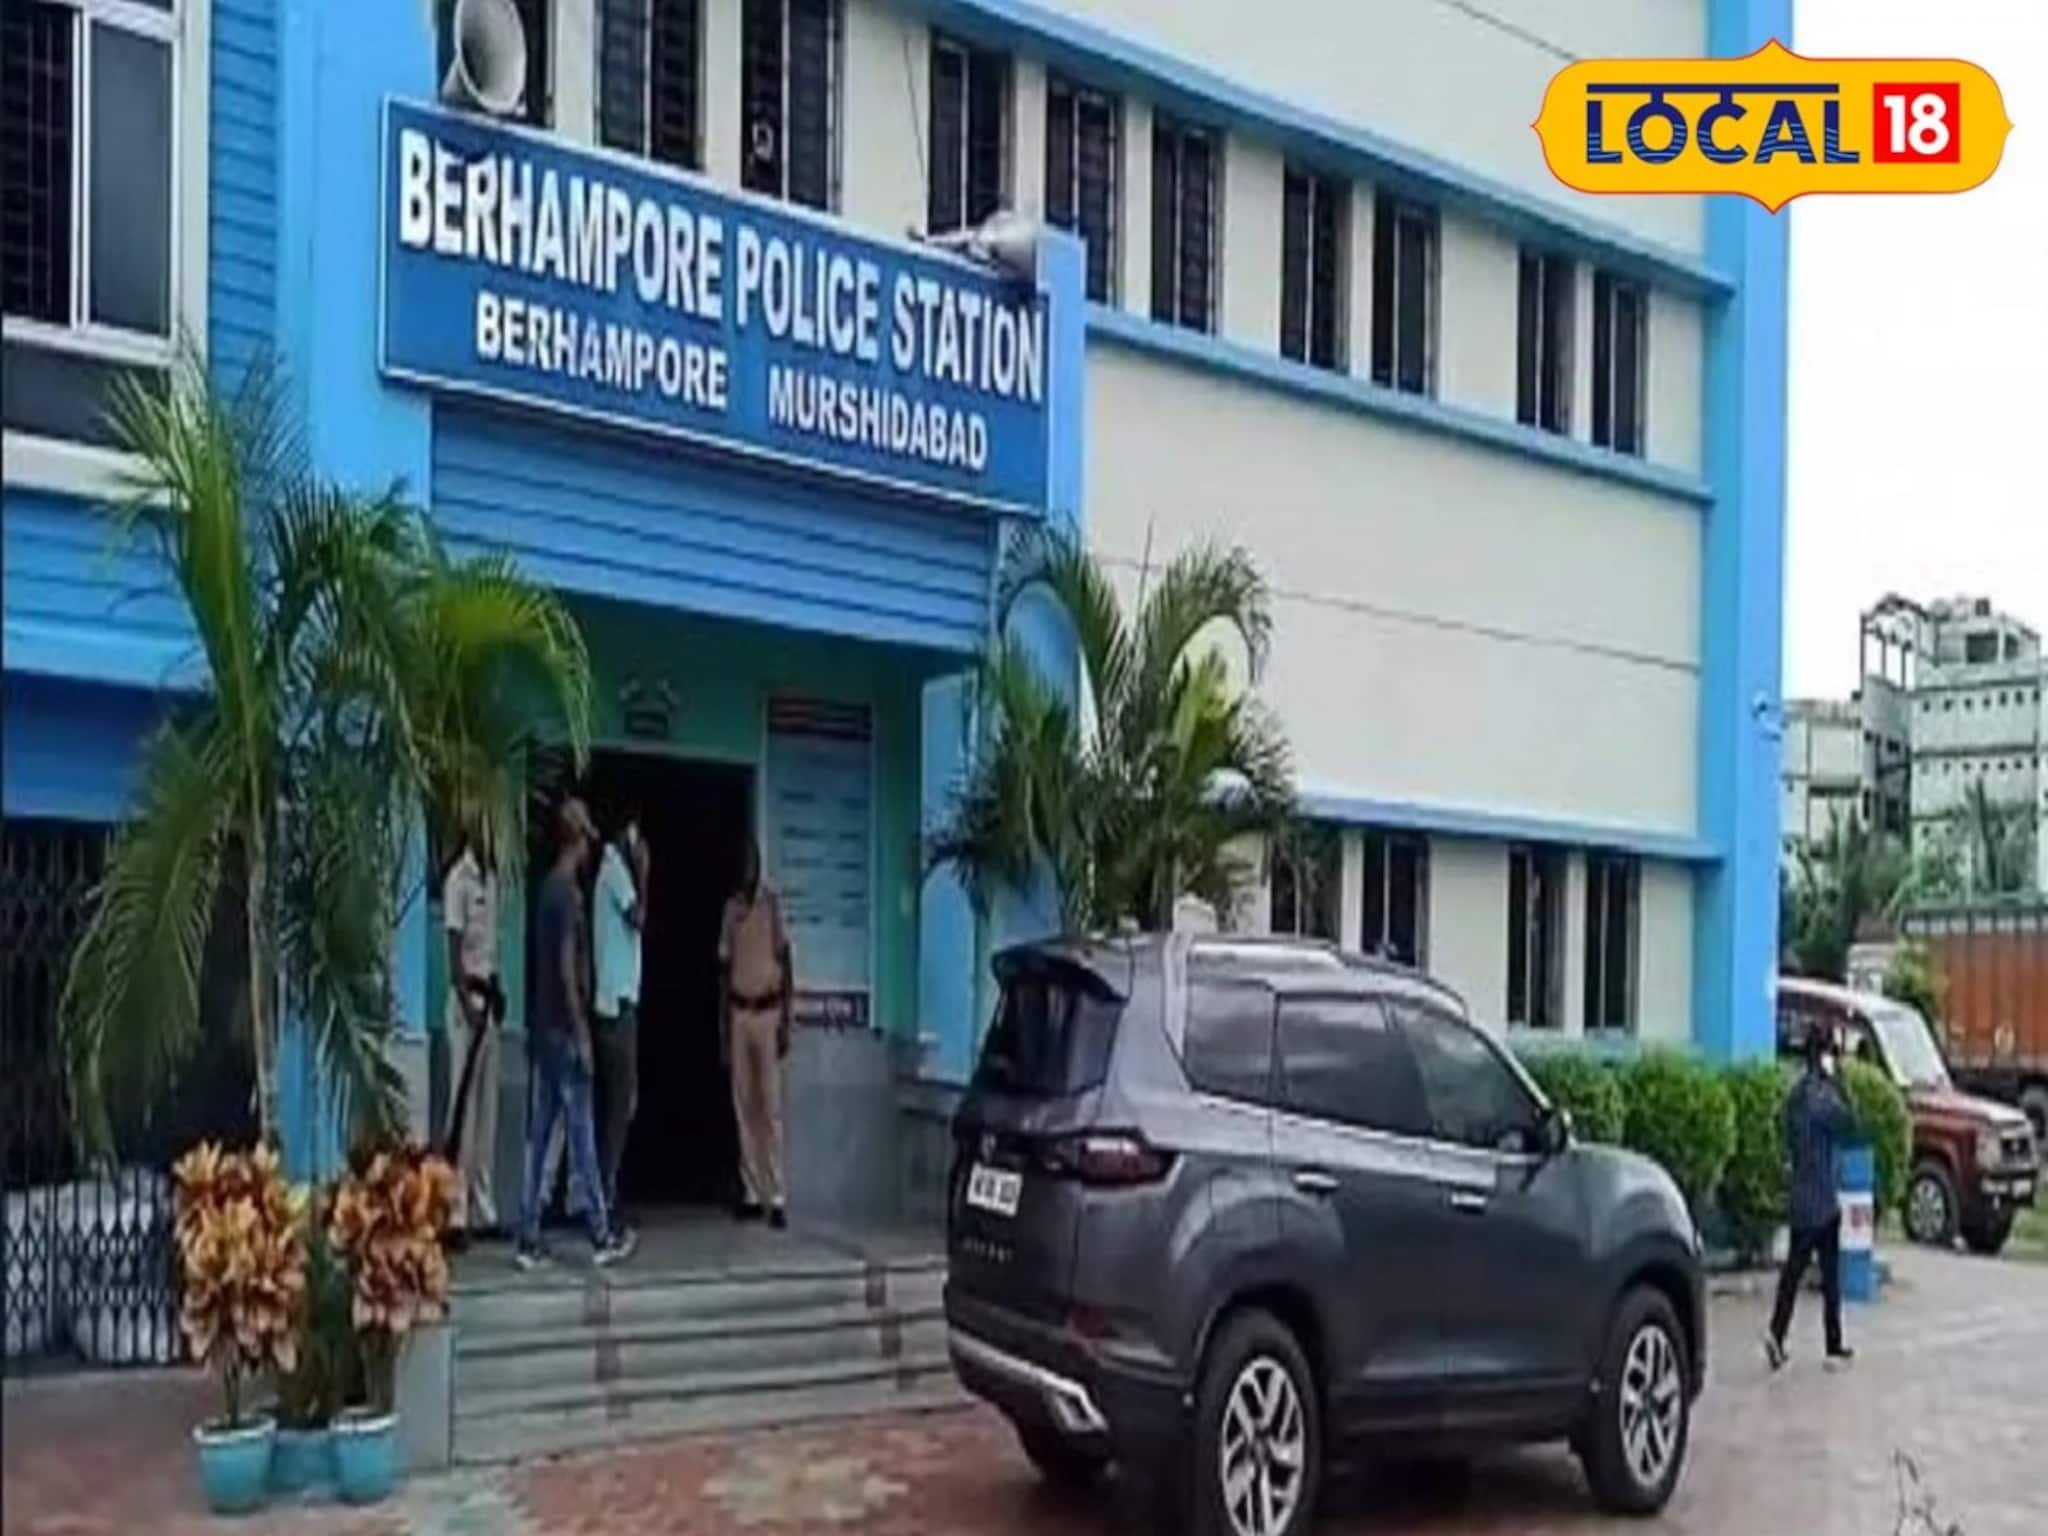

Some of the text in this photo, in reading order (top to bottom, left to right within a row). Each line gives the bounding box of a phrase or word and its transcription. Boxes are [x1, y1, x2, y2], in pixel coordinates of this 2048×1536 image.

[399, 127, 1043, 402] BERHAMPORE POLICE STATION
[475, 291, 988, 471] BERHAMPORE MURSHIDABAD
